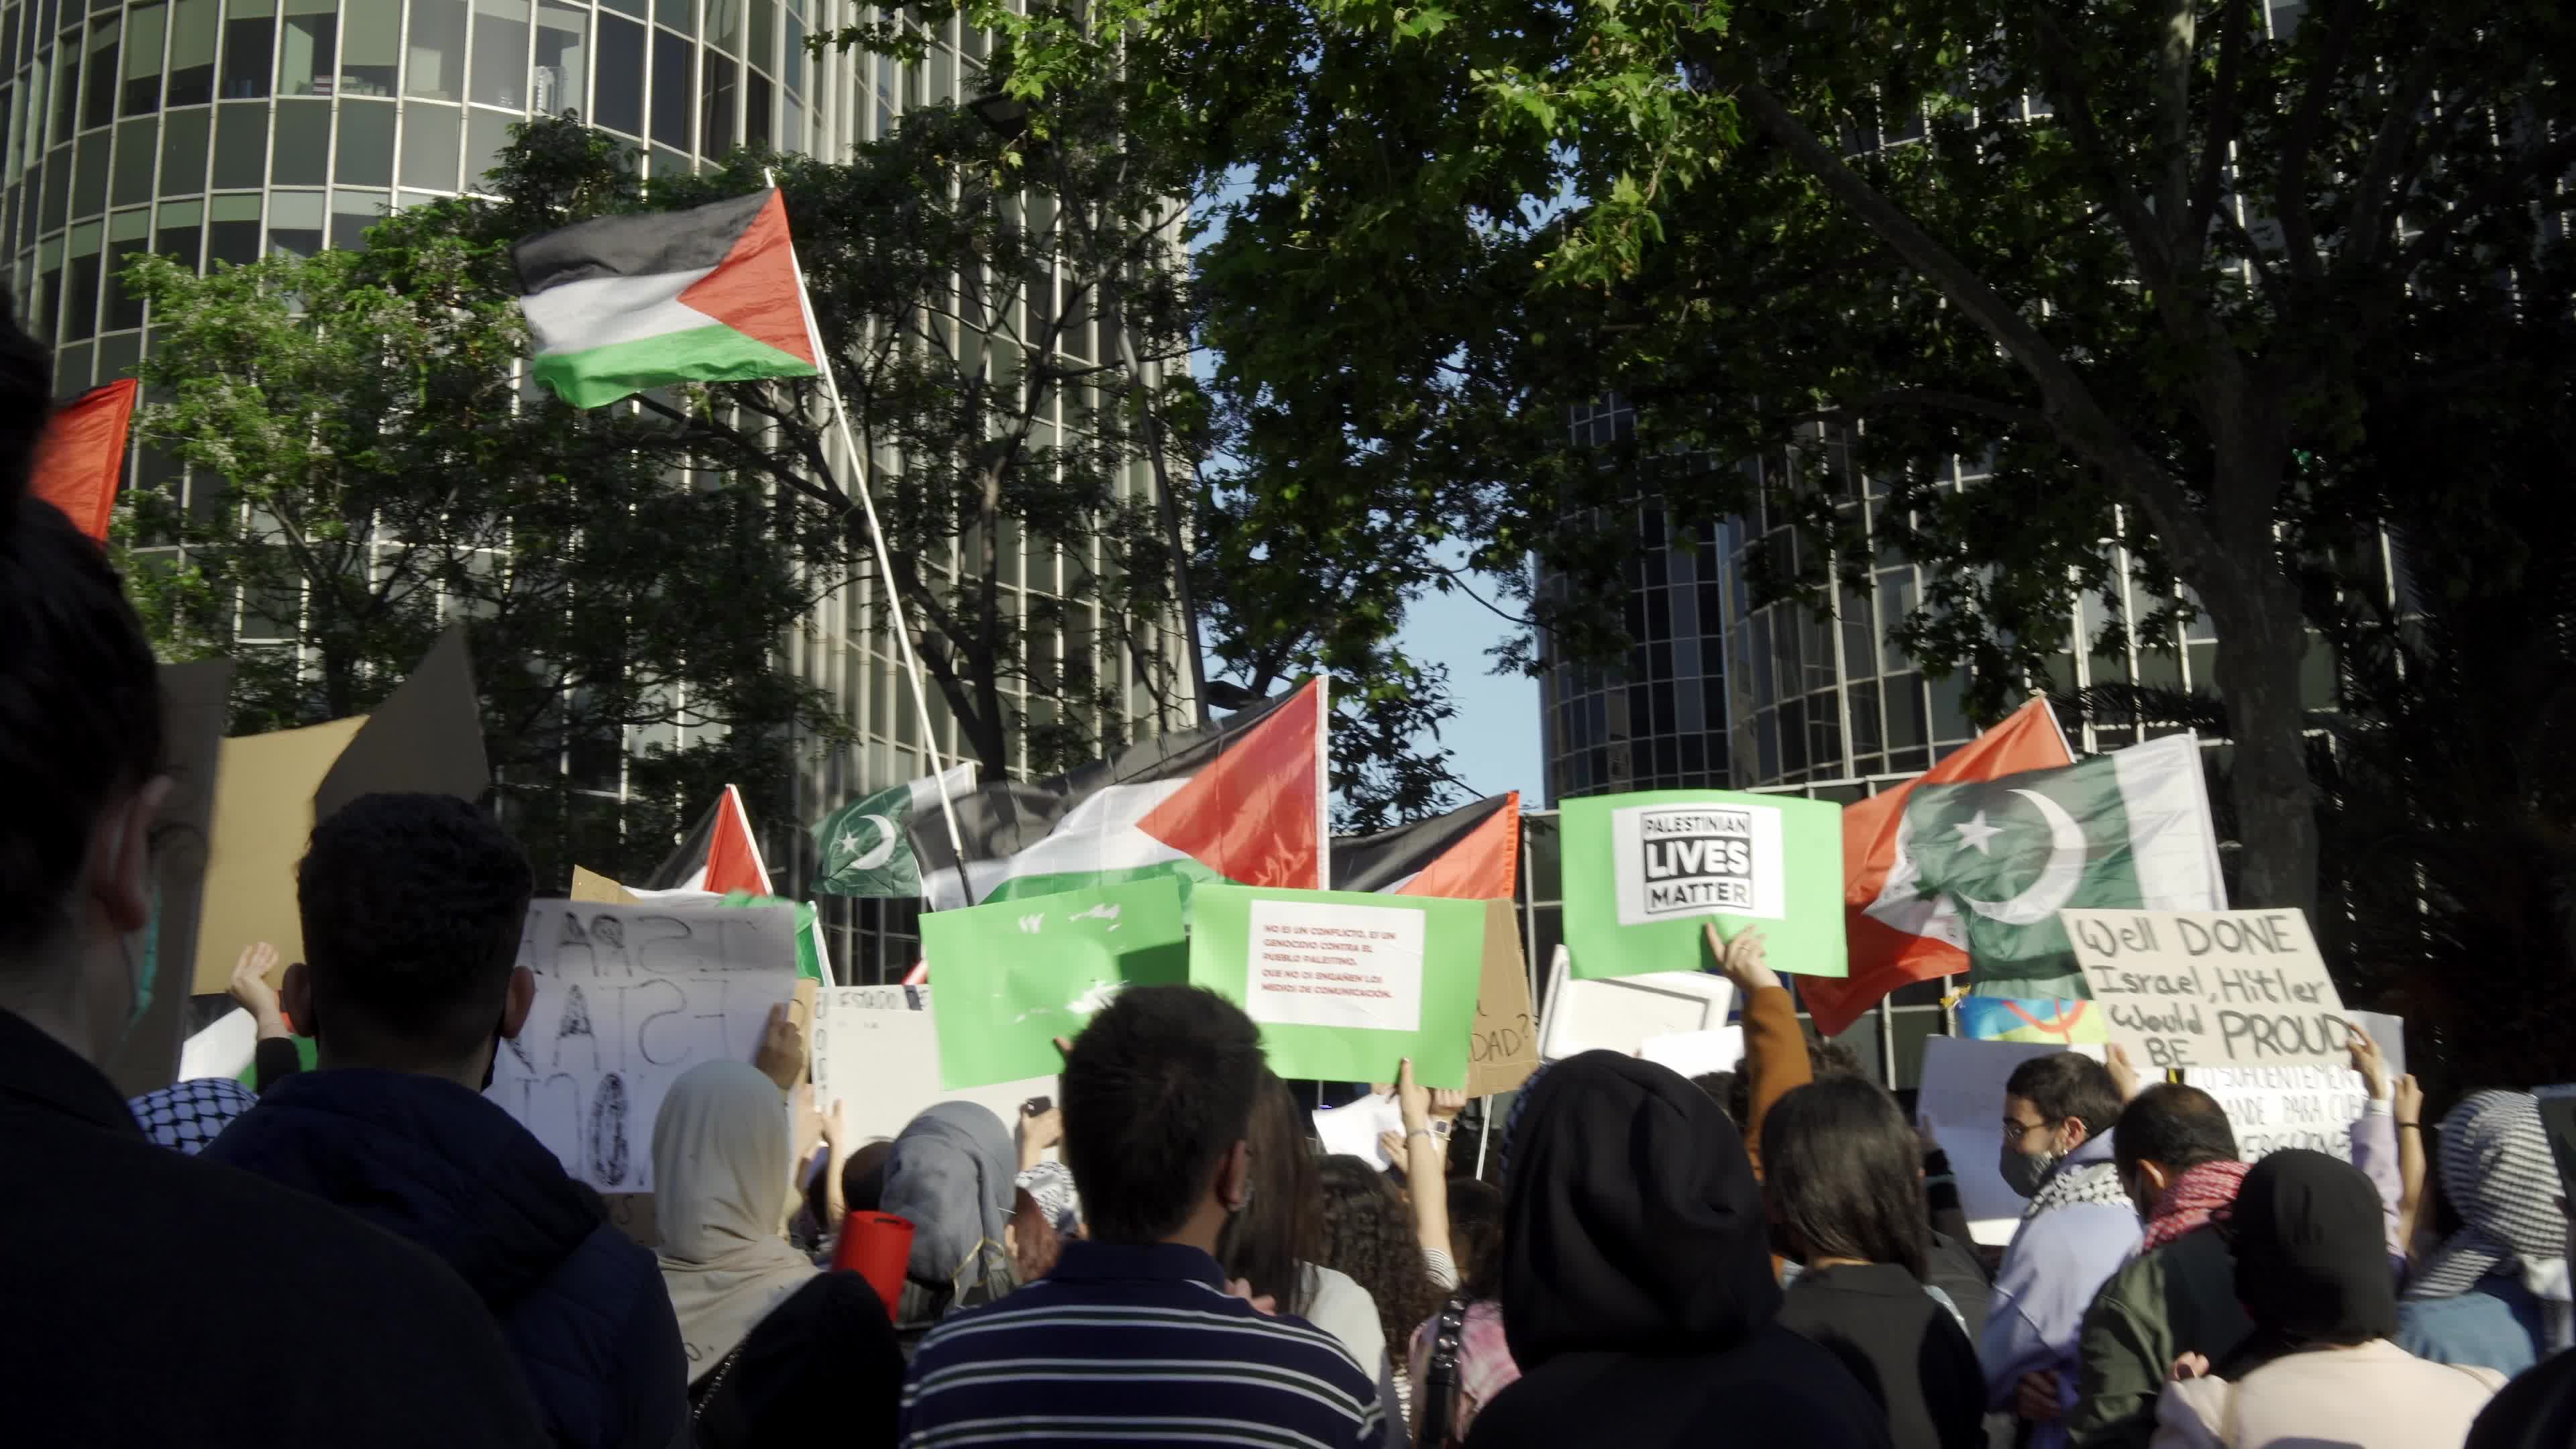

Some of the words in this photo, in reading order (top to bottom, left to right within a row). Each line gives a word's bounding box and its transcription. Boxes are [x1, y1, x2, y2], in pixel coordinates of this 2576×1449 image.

[1644, 815, 1750, 833] PALESTINIAN
[1646, 839, 1750, 878] LIVES
[1646, 882, 1748, 907] MATTER
[1264, 925, 1279, 933] NO
[1381, 931, 1397, 939] UN
[2076, 916, 2159, 957] Well
[2174, 914, 2299, 955] DONE
[1263, 938, 1318, 949] GENOCIDIO
[1320, 942, 1359, 951] CONTRA
[1361, 944, 1373, 953] EL
[1262, 953, 1300, 962] PUEBLO
[1261, 969, 1283, 977] QUE
[1284, 970, 1299, 978] NO
[1364, 975, 1383, 983] LOS
[2215, 966, 2324, 1004] Hitler
[1261, 983, 1295, 992] MEDIOS
[1299, 985, 1311, 993] DE
[2143, 1036, 2198, 1066] BE
[2216, 1009, 2355, 1060] PROUD
